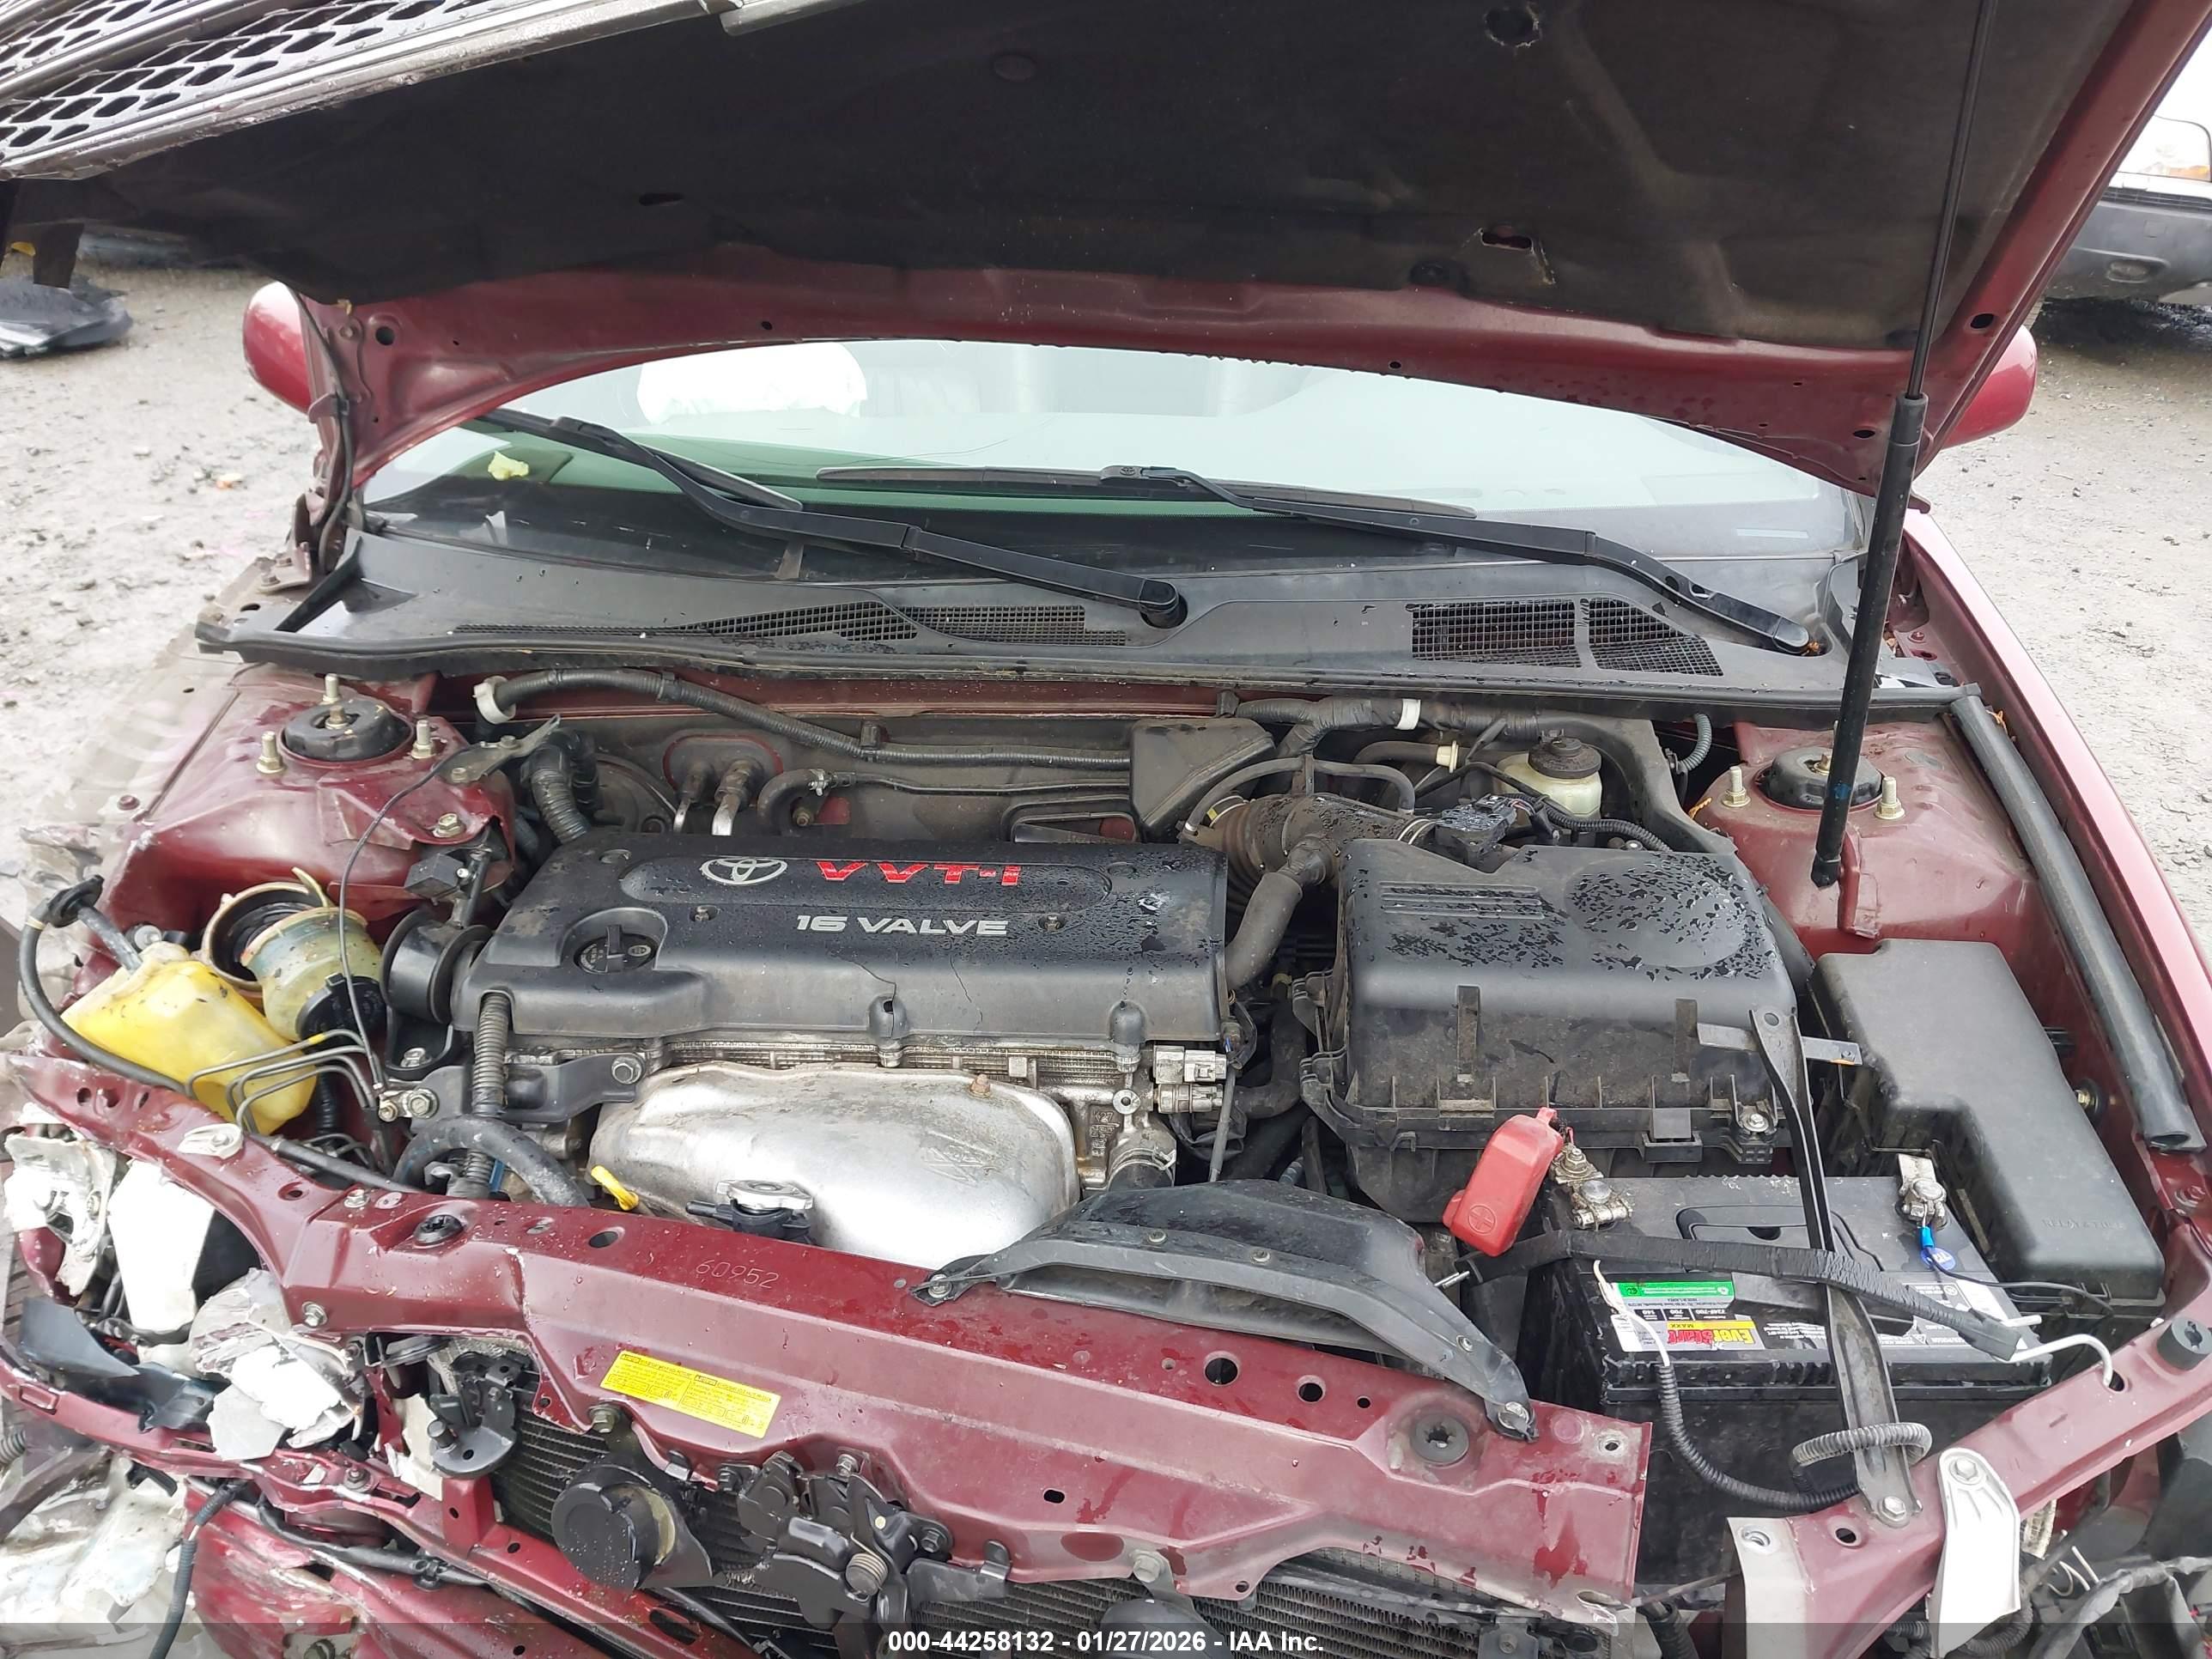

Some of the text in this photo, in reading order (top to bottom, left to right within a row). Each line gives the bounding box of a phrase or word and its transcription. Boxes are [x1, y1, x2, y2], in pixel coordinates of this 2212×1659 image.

[797, 915, 1009, 936] 16 VALVE
[696, 1259, 780, 1289] 60952
[1667, 1328, 1754, 1345] EverStart
